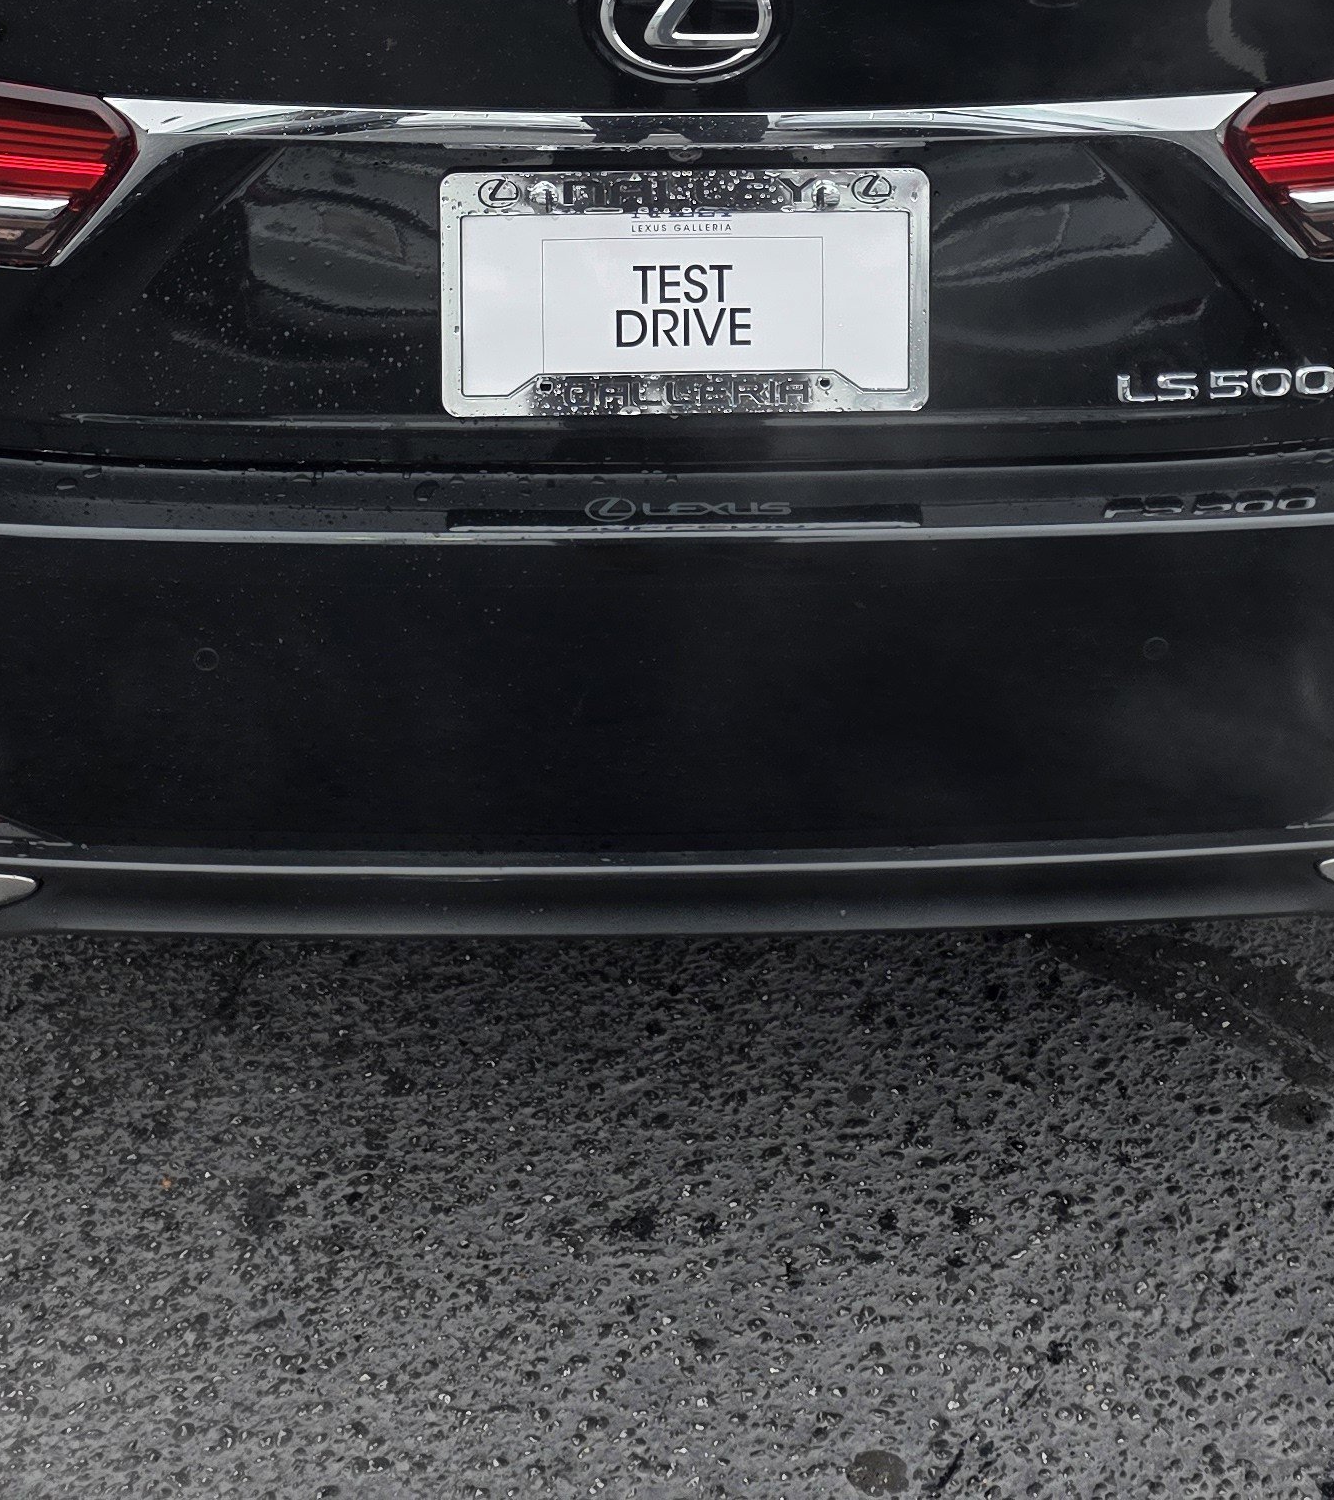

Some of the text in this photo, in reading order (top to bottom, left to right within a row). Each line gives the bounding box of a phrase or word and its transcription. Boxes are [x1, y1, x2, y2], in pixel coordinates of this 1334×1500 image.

[631, 222, 733, 234] LEXUS GALLERIA
[632, 264, 734, 305] TEST
[615, 308, 753, 349] DRIVE
[563, 377, 813, 408] GALLERIA
[1116, 372, 1200, 403] LS
[641, 501, 793, 517] LEXUS
